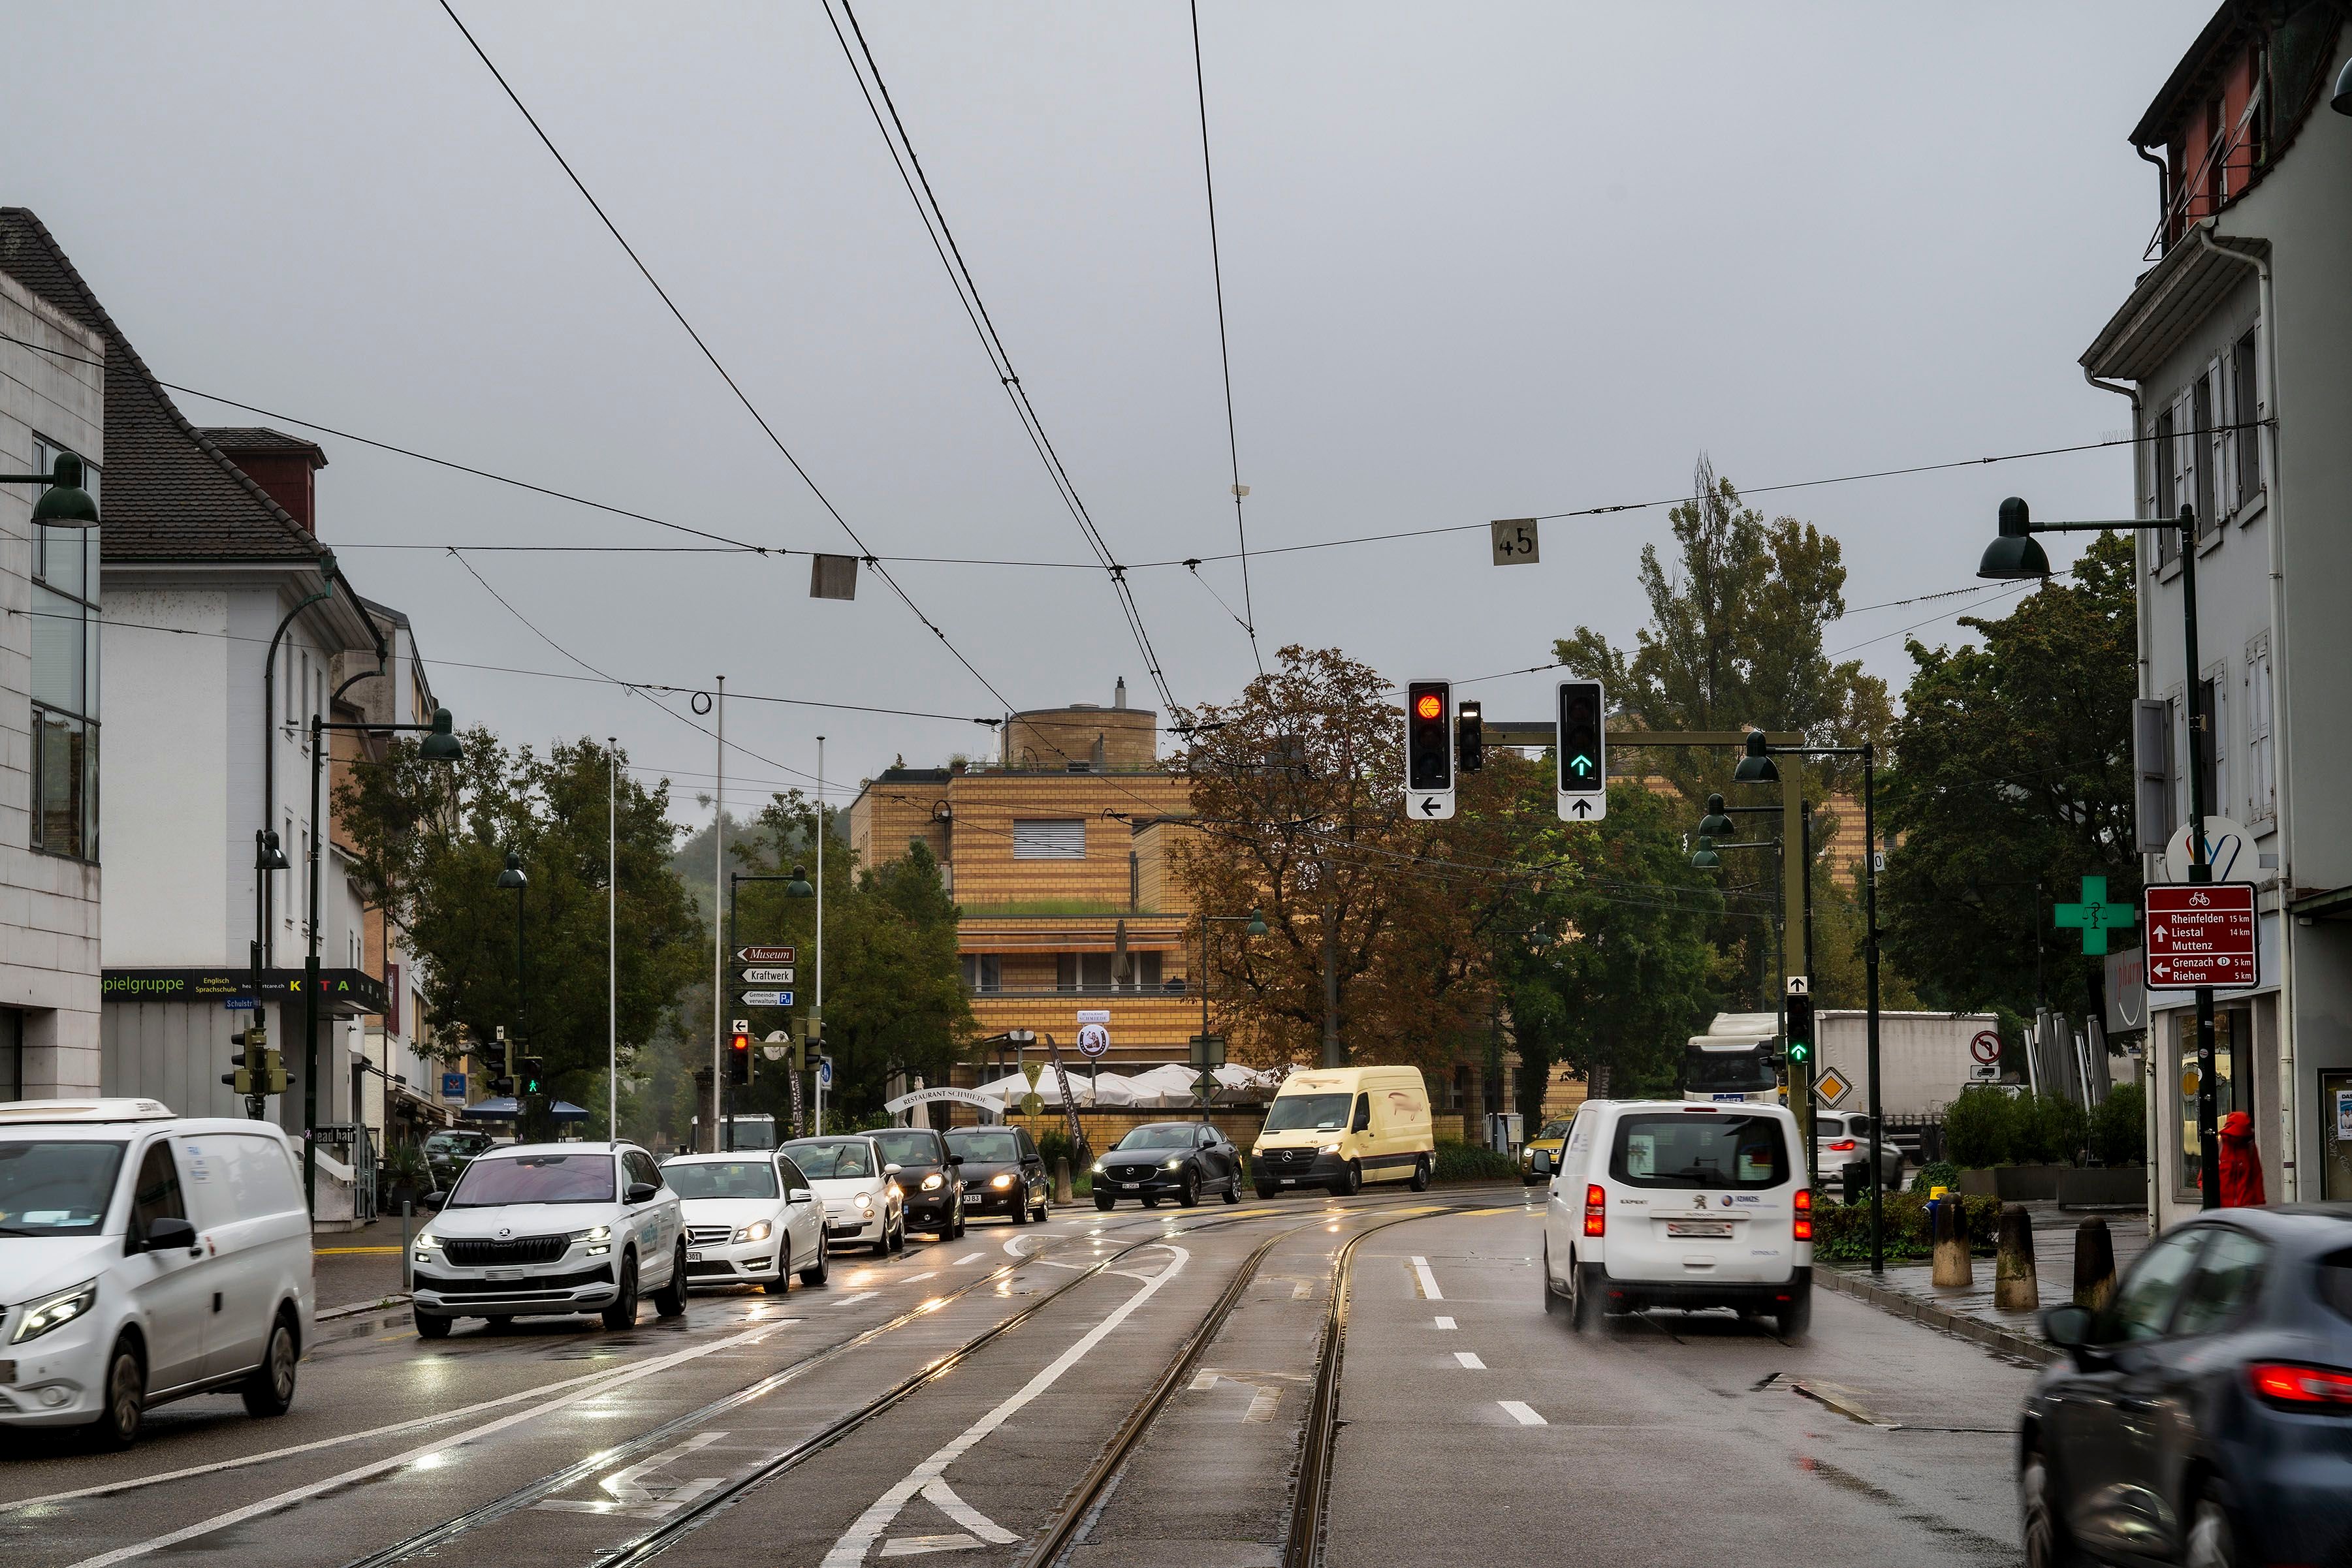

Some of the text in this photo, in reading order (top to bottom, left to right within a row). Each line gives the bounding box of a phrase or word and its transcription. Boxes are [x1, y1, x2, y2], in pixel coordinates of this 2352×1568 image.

[1499, 527, 1532, 556] 45
[2171, 913, 2224, 924] Rheinfelden
[2172, 927, 2204, 937] Liestal
[2172, 941, 2213, 950] Muttenz
[750, 949, 789, 959] Museum
[2172, 957, 2214, 967] Grenzach
[752, 970, 789, 980] Kraftwerk
[2173, 971, 2206, 980] Riehen
[903, 1090, 988, 1105] RESTAURANT SCHMIEDE
[315, 1129, 334, 1142] ead
